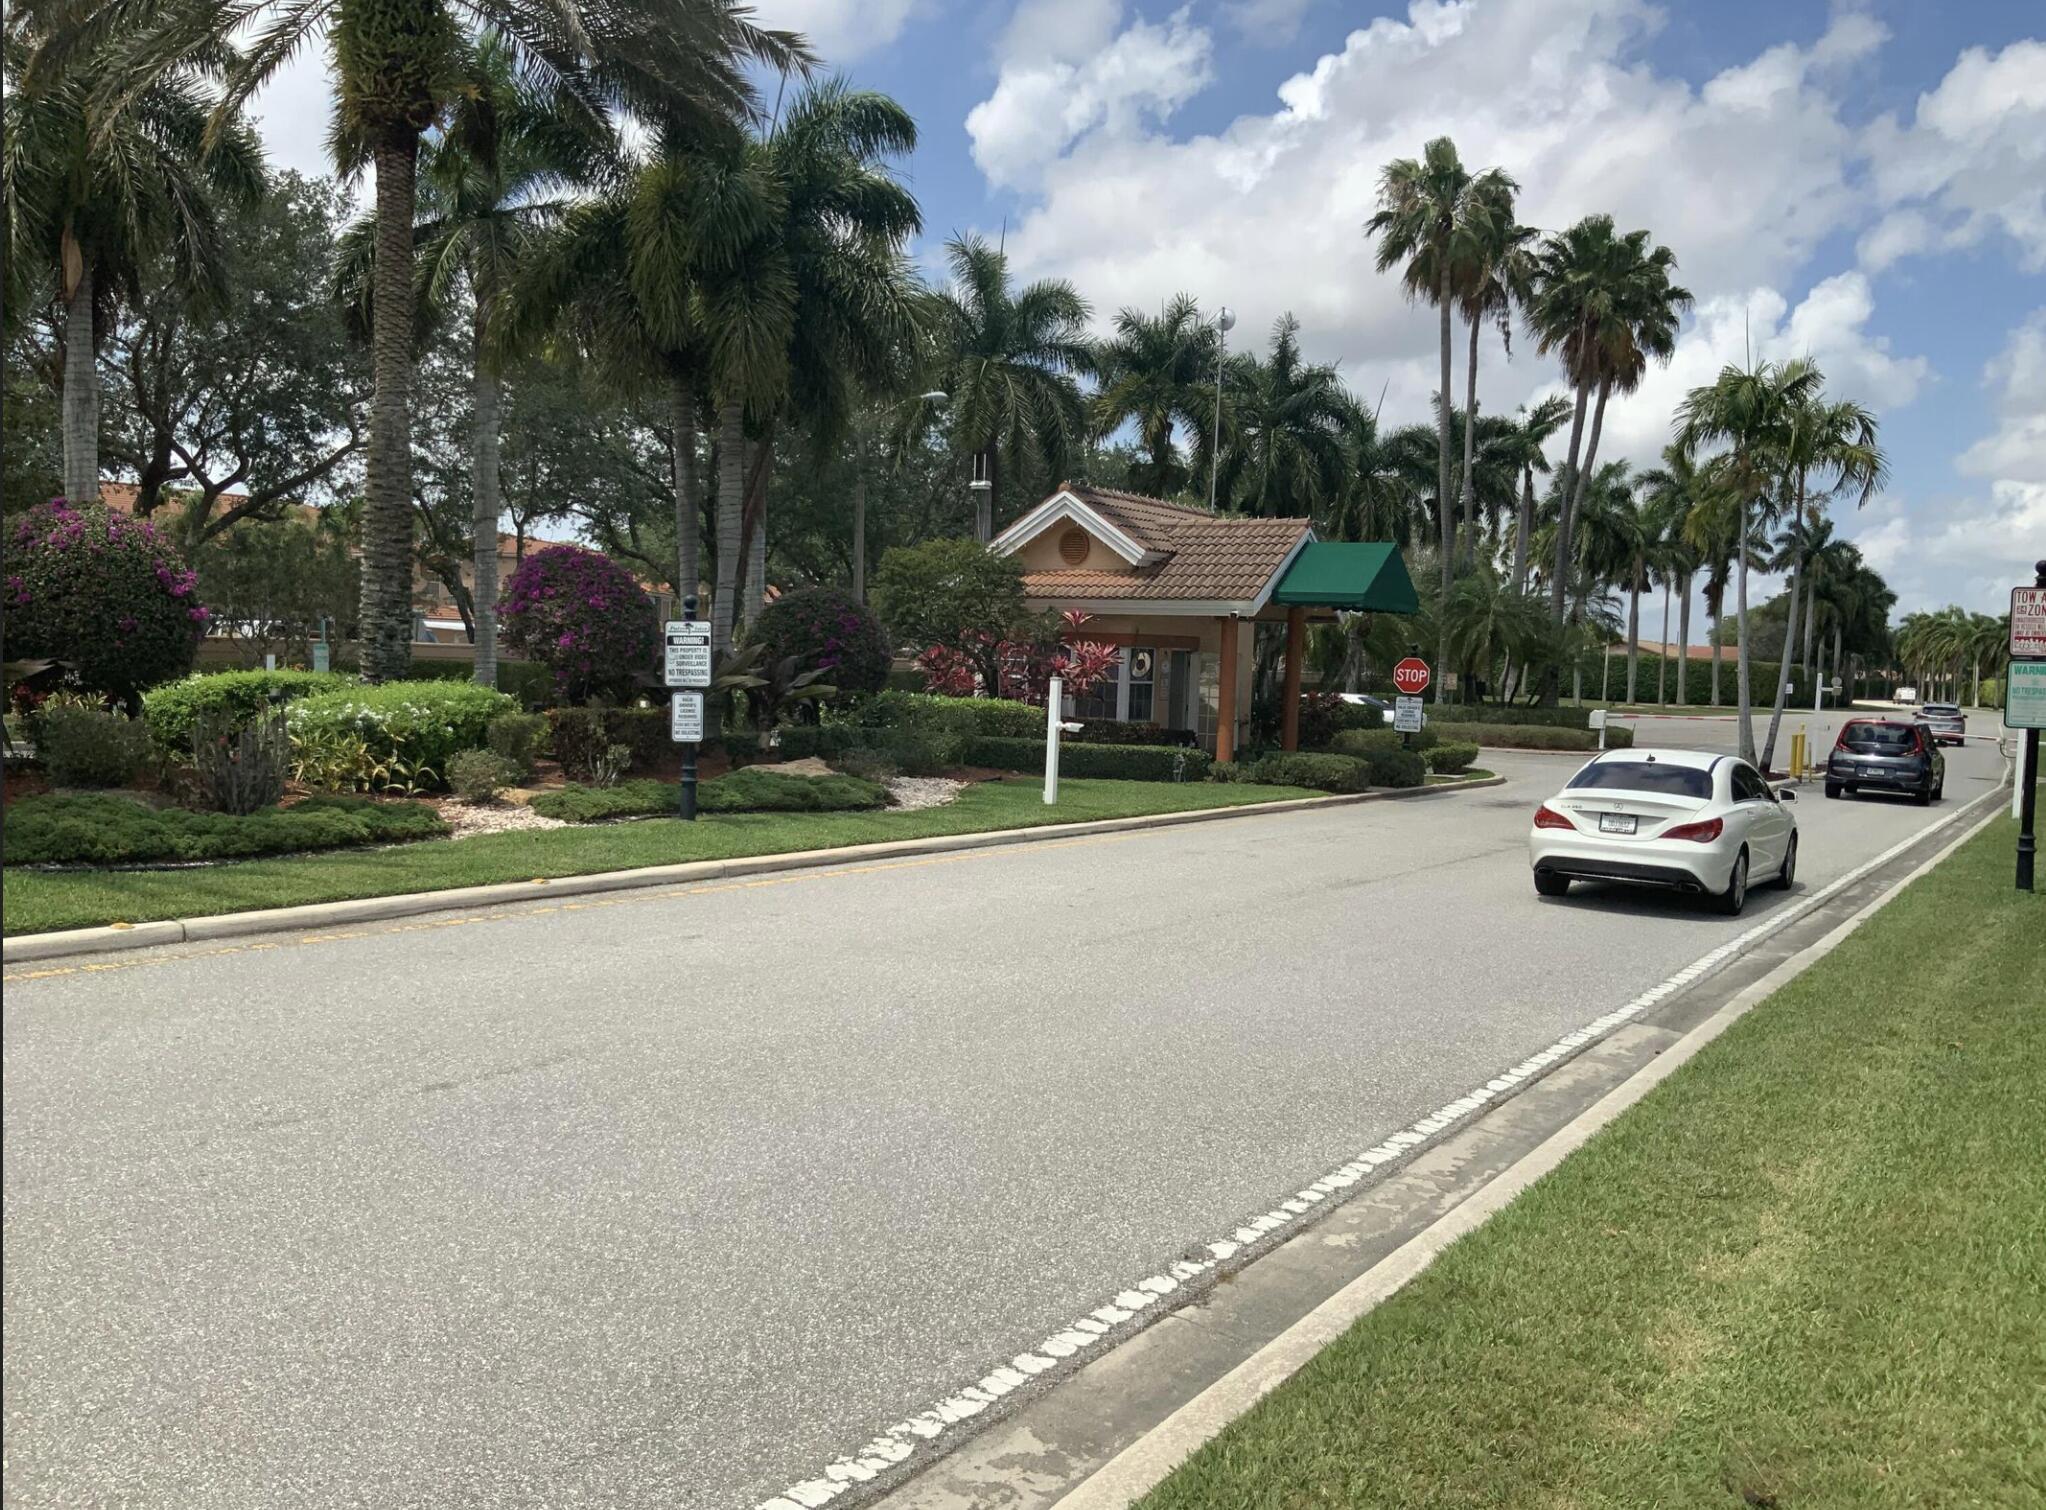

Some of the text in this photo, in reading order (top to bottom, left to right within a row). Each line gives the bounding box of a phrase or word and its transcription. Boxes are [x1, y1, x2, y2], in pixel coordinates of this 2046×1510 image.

[2017, 592, 2036, 603] TOW
[673, 637, 704, 645] WARNING!
[1397, 669, 1427, 682] STOP
